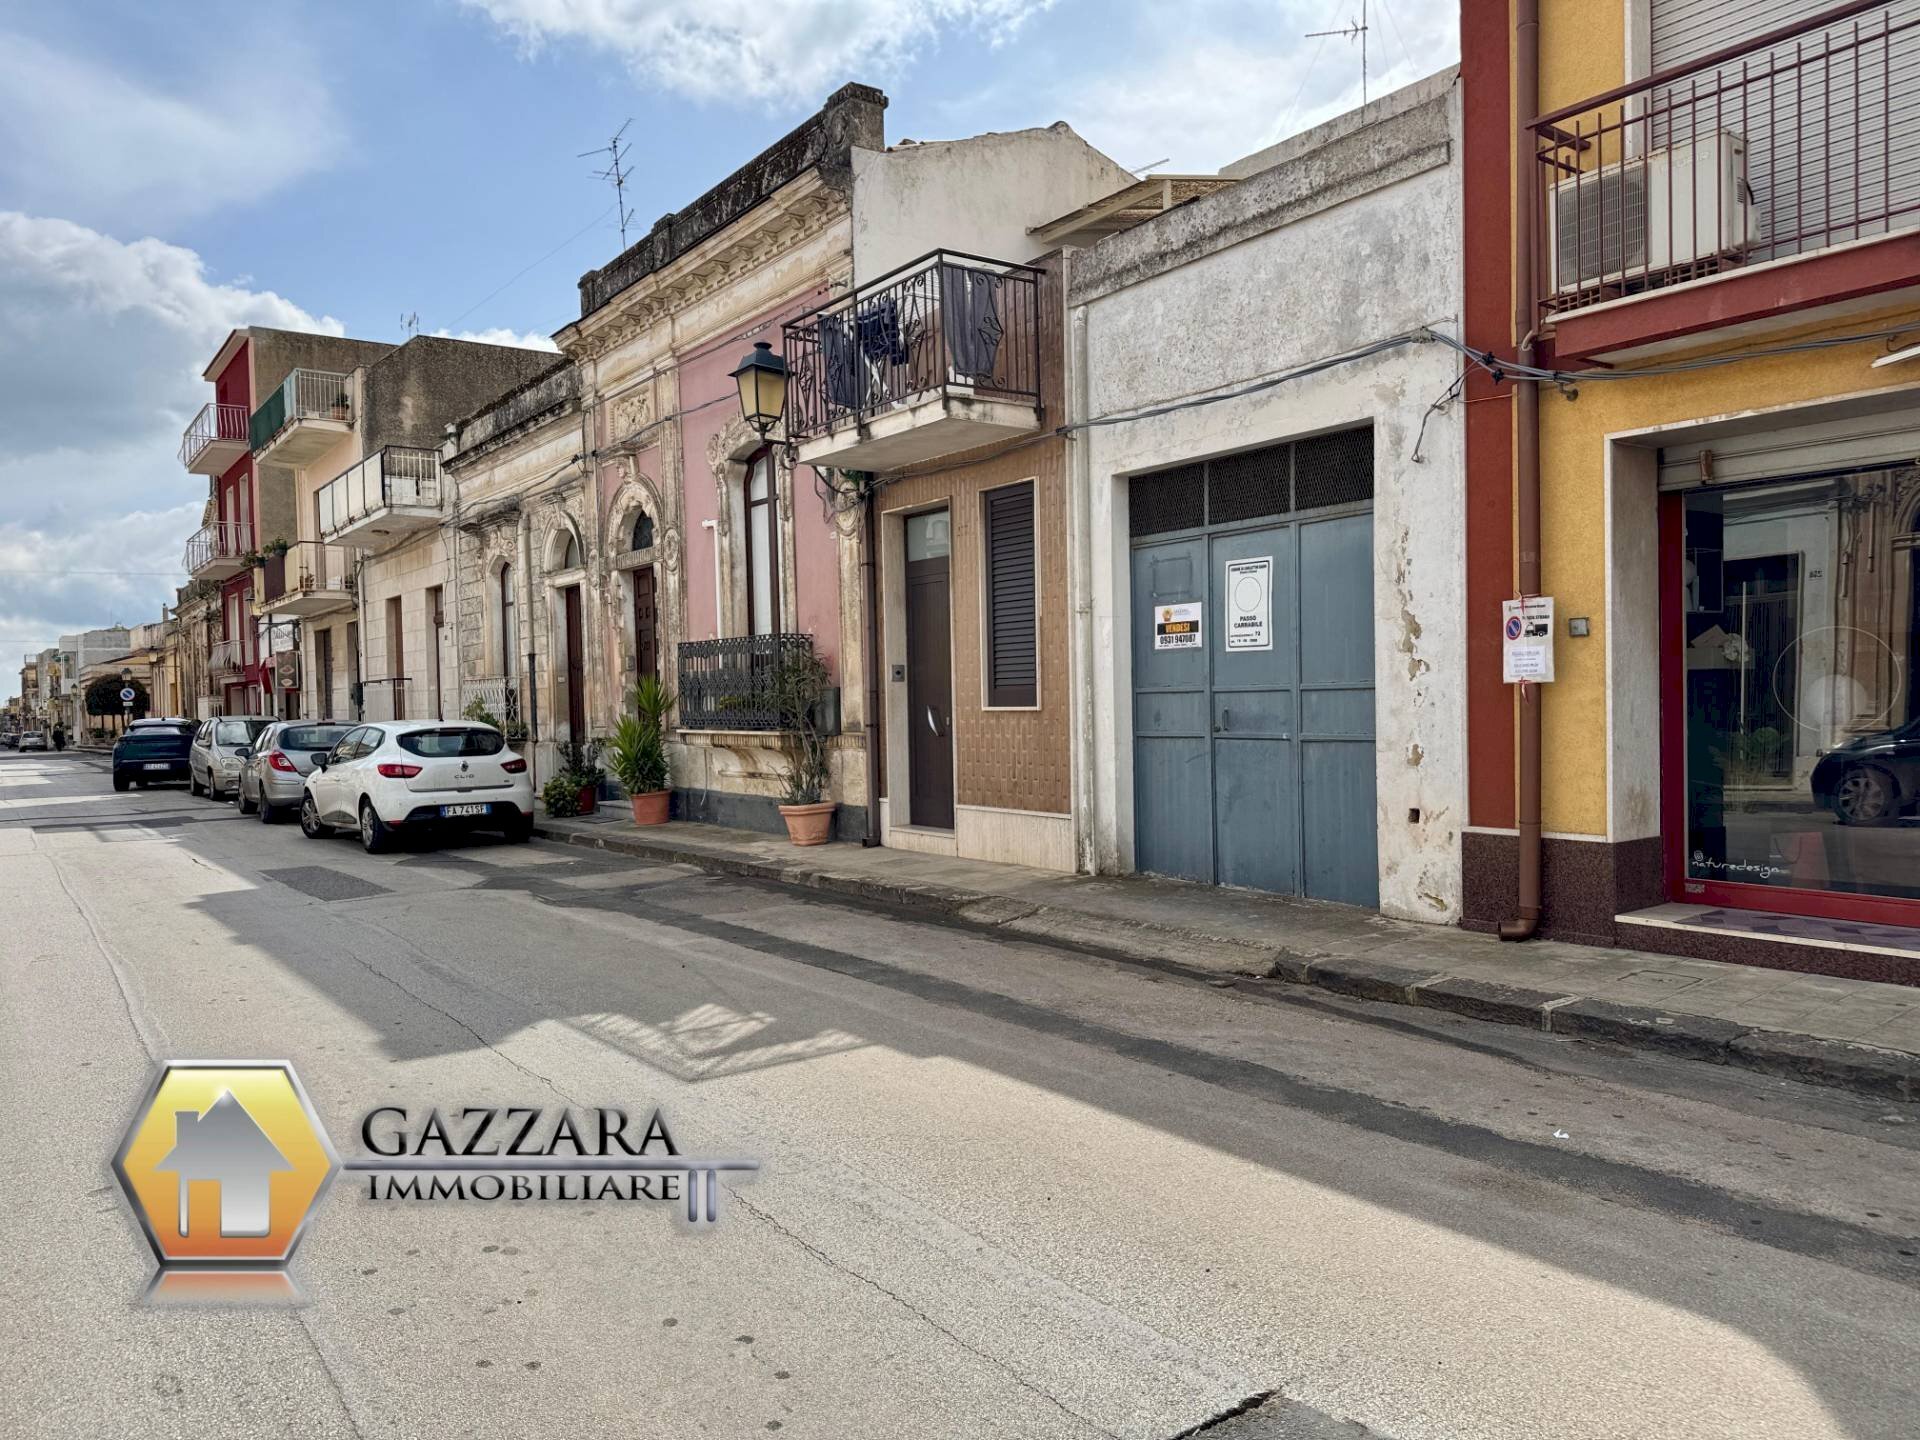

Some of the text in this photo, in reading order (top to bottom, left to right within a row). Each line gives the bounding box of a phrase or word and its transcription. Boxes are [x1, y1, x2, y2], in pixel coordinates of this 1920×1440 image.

[1165, 622, 1191, 634] VENDESI
[1233, 621, 1263, 629] CARRABILE
[446, 806, 457, 816] FA
